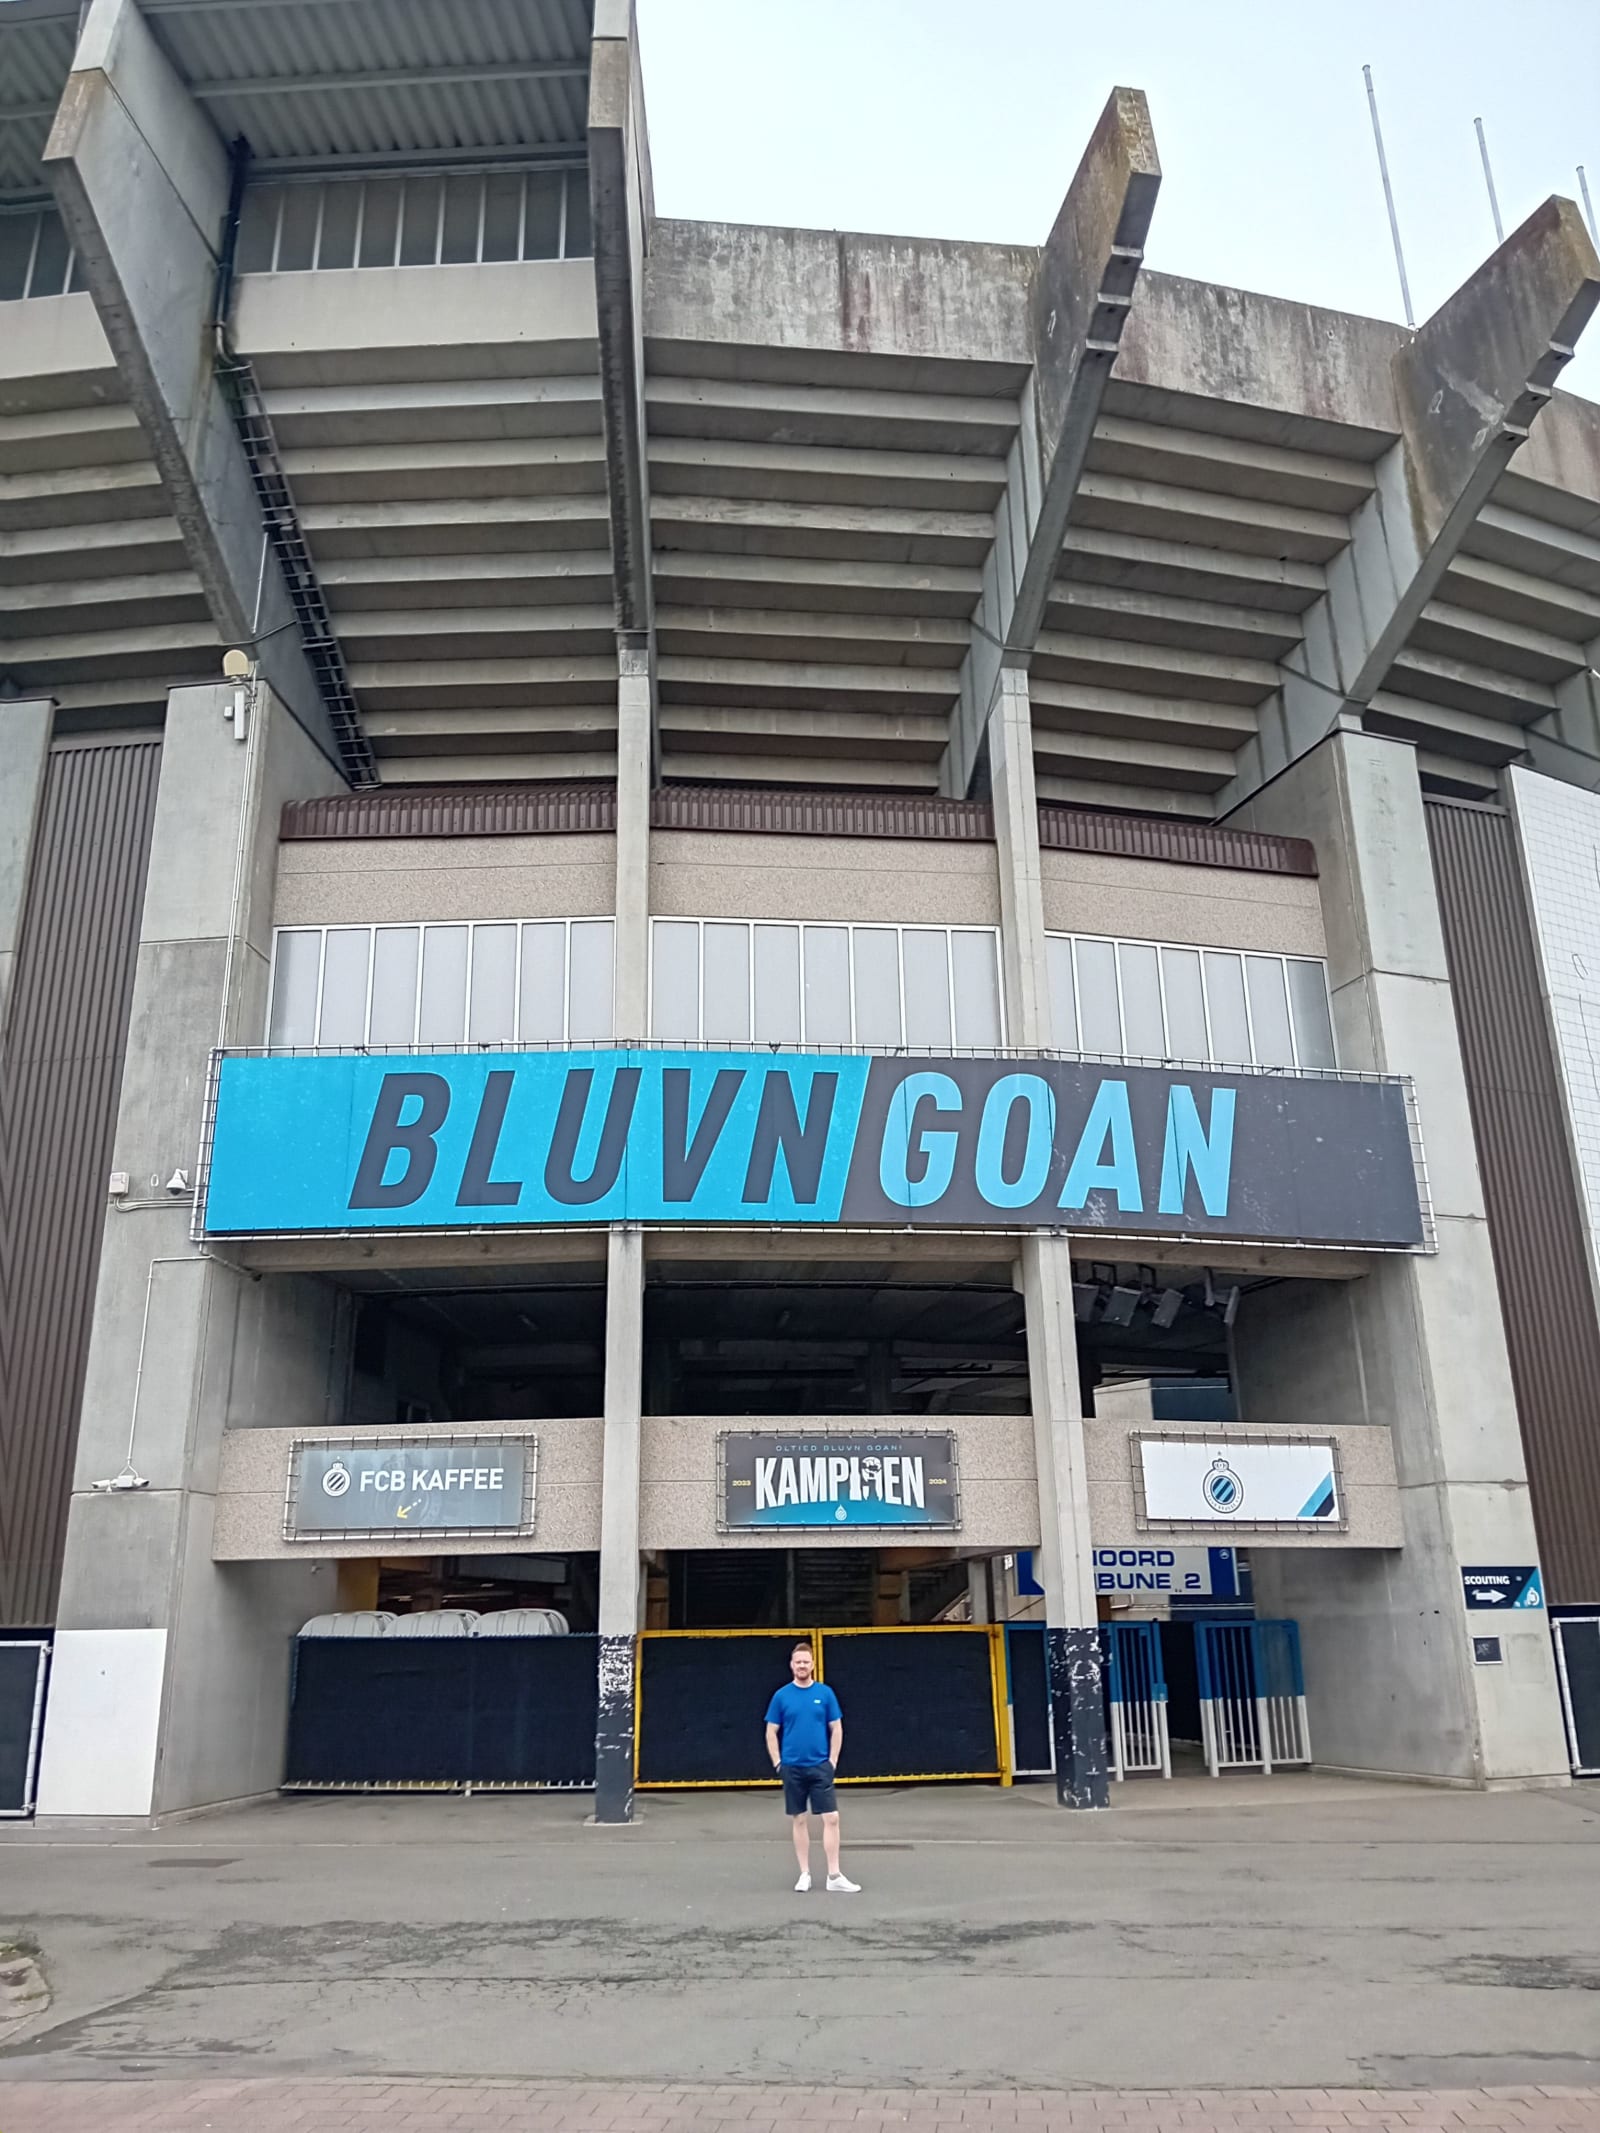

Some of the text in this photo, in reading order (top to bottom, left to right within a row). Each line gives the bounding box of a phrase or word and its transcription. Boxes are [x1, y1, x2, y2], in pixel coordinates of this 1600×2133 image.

[347, 1068, 1236, 1217] BLUVN GOAN
[360, 1468, 504, 1492] FCB KAFFEE
[1184, 1573, 1201, 1589] 2
[1464, 1575, 1510, 1585] SCOUTING
